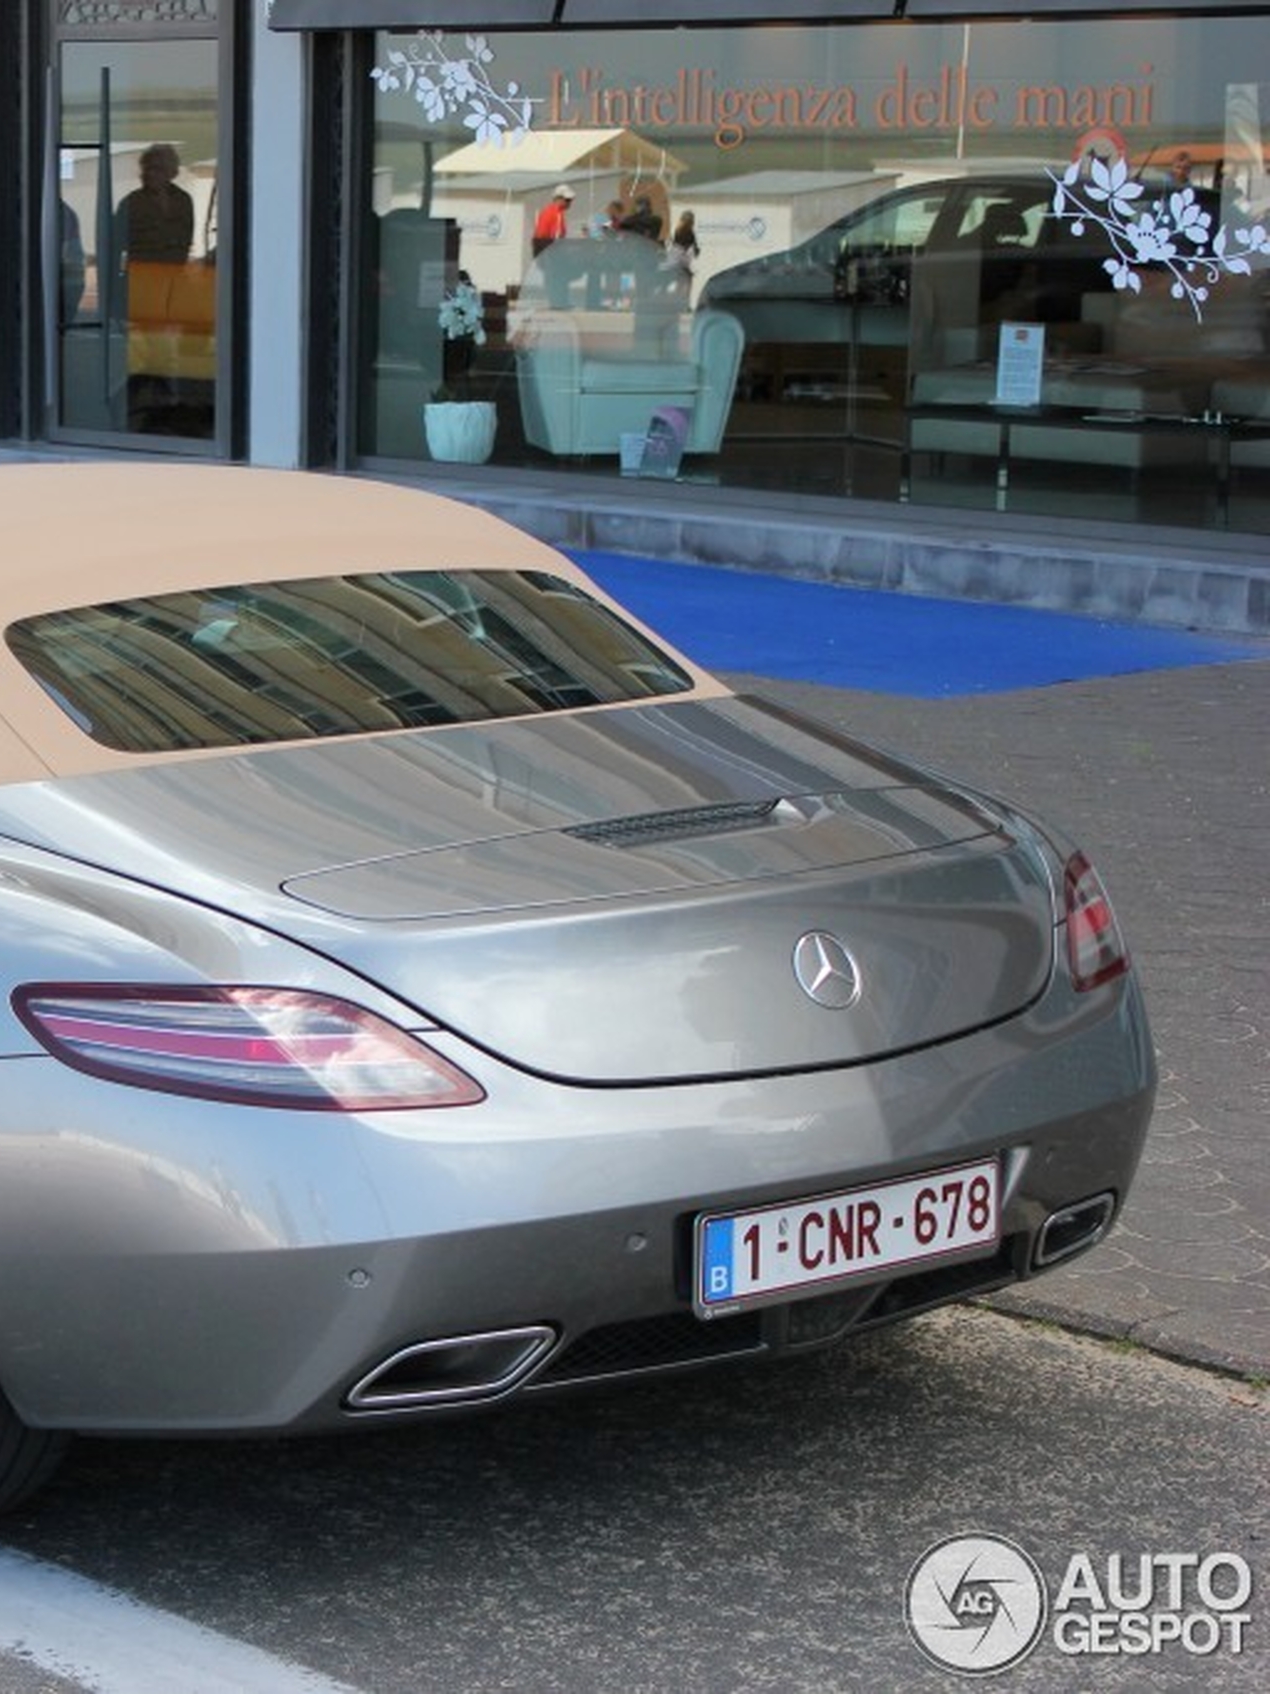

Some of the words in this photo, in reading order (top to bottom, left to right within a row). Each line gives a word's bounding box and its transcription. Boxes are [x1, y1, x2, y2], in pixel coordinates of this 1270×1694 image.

[547, 66, 857, 149] L'intelligenza
[876, 59, 998, 128] delle
[1014, 62, 1154, 128] mani
[711, 1266, 729, 1293] B
[743, 1175, 991, 1281] 1-CNR-678
